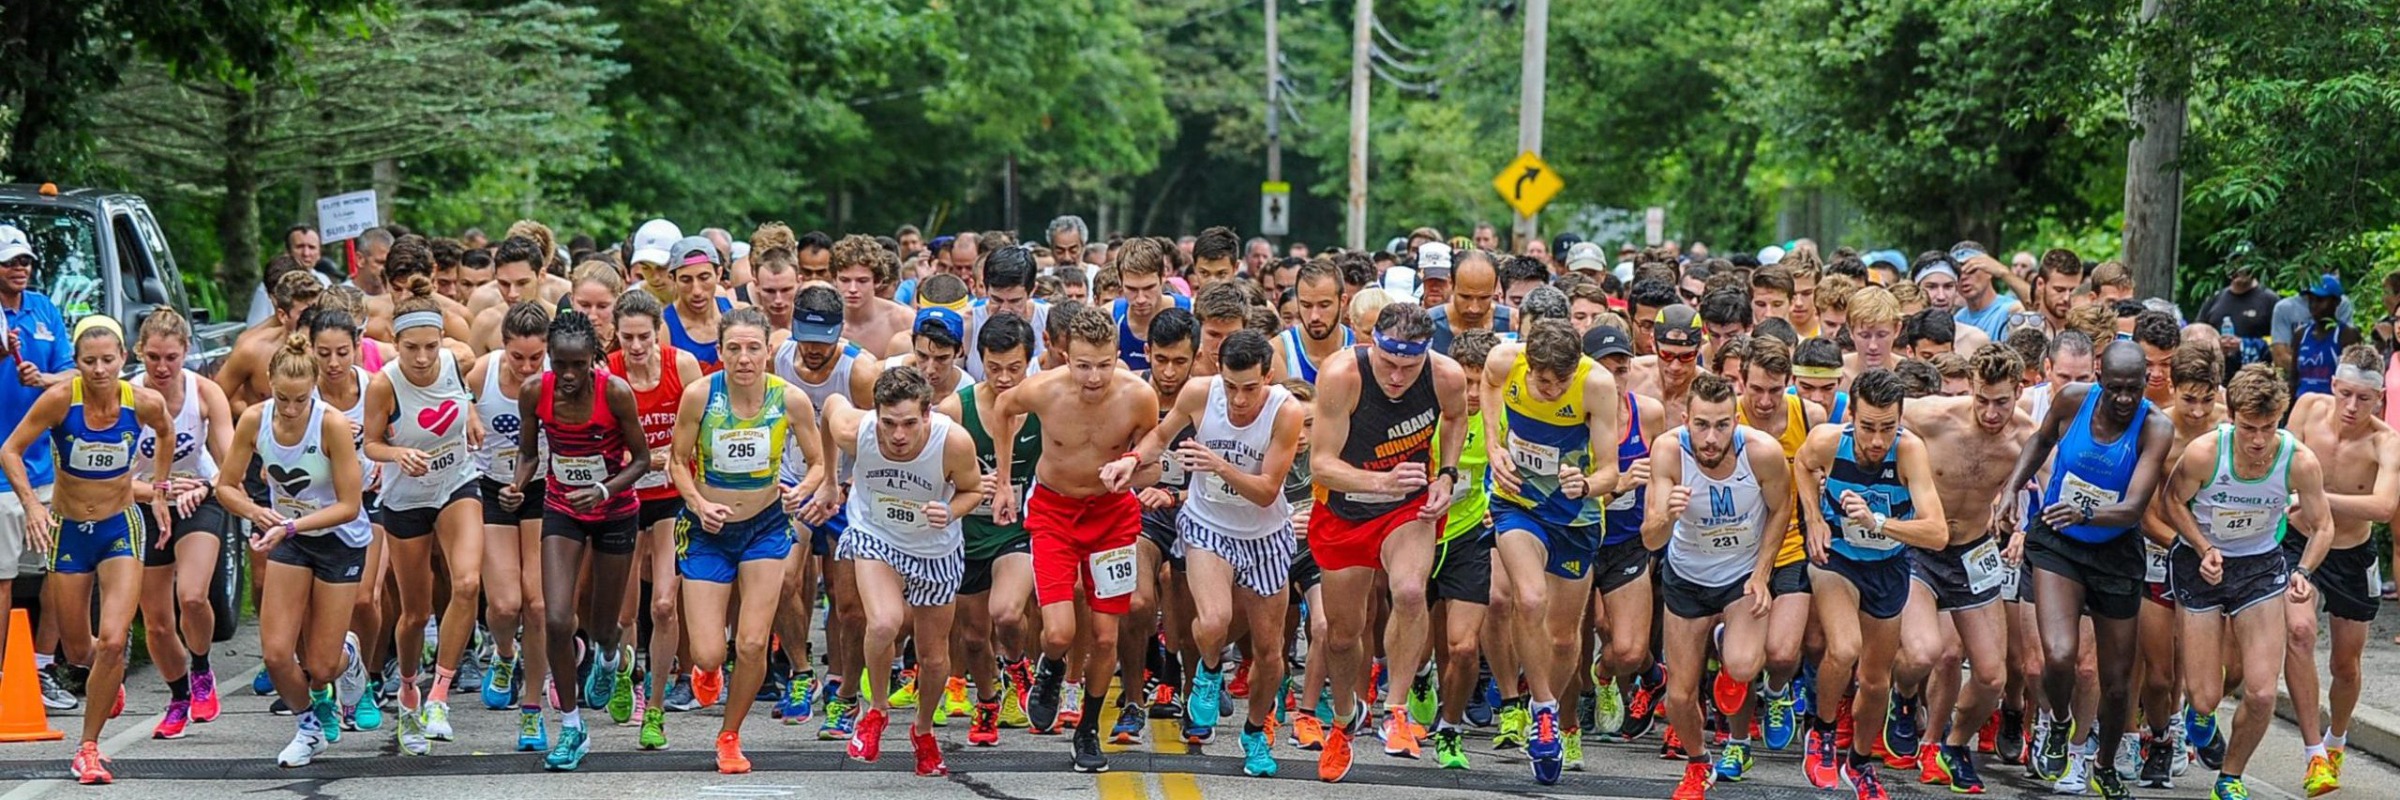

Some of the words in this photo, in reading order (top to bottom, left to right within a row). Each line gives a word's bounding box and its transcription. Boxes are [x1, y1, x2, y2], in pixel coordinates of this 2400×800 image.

[1386, 407, 1436, 440] ALBANY
[1374, 424, 1434, 458] RUNNING
[727, 442, 756, 458] 295
[86, 454, 114, 467] 198
[430, 452, 455, 471] 403
[1518, 450, 1543, 470] 110
[565, 469, 593, 481] 286
[865, 468, 899, 479] JOHNSON
[906, 471, 933, 491] WALES
[886, 478, 911, 492] A.C.
[1709, 485, 1736, 518] M
[2228, 495, 2262, 505] TOGHER
[886, 507, 915, 523] 389
[2226, 518, 2253, 529] 421
[1712, 535, 1740, 548] 231
[1106, 561, 1133, 581] 139
[1978, 553, 1999, 575] 199
